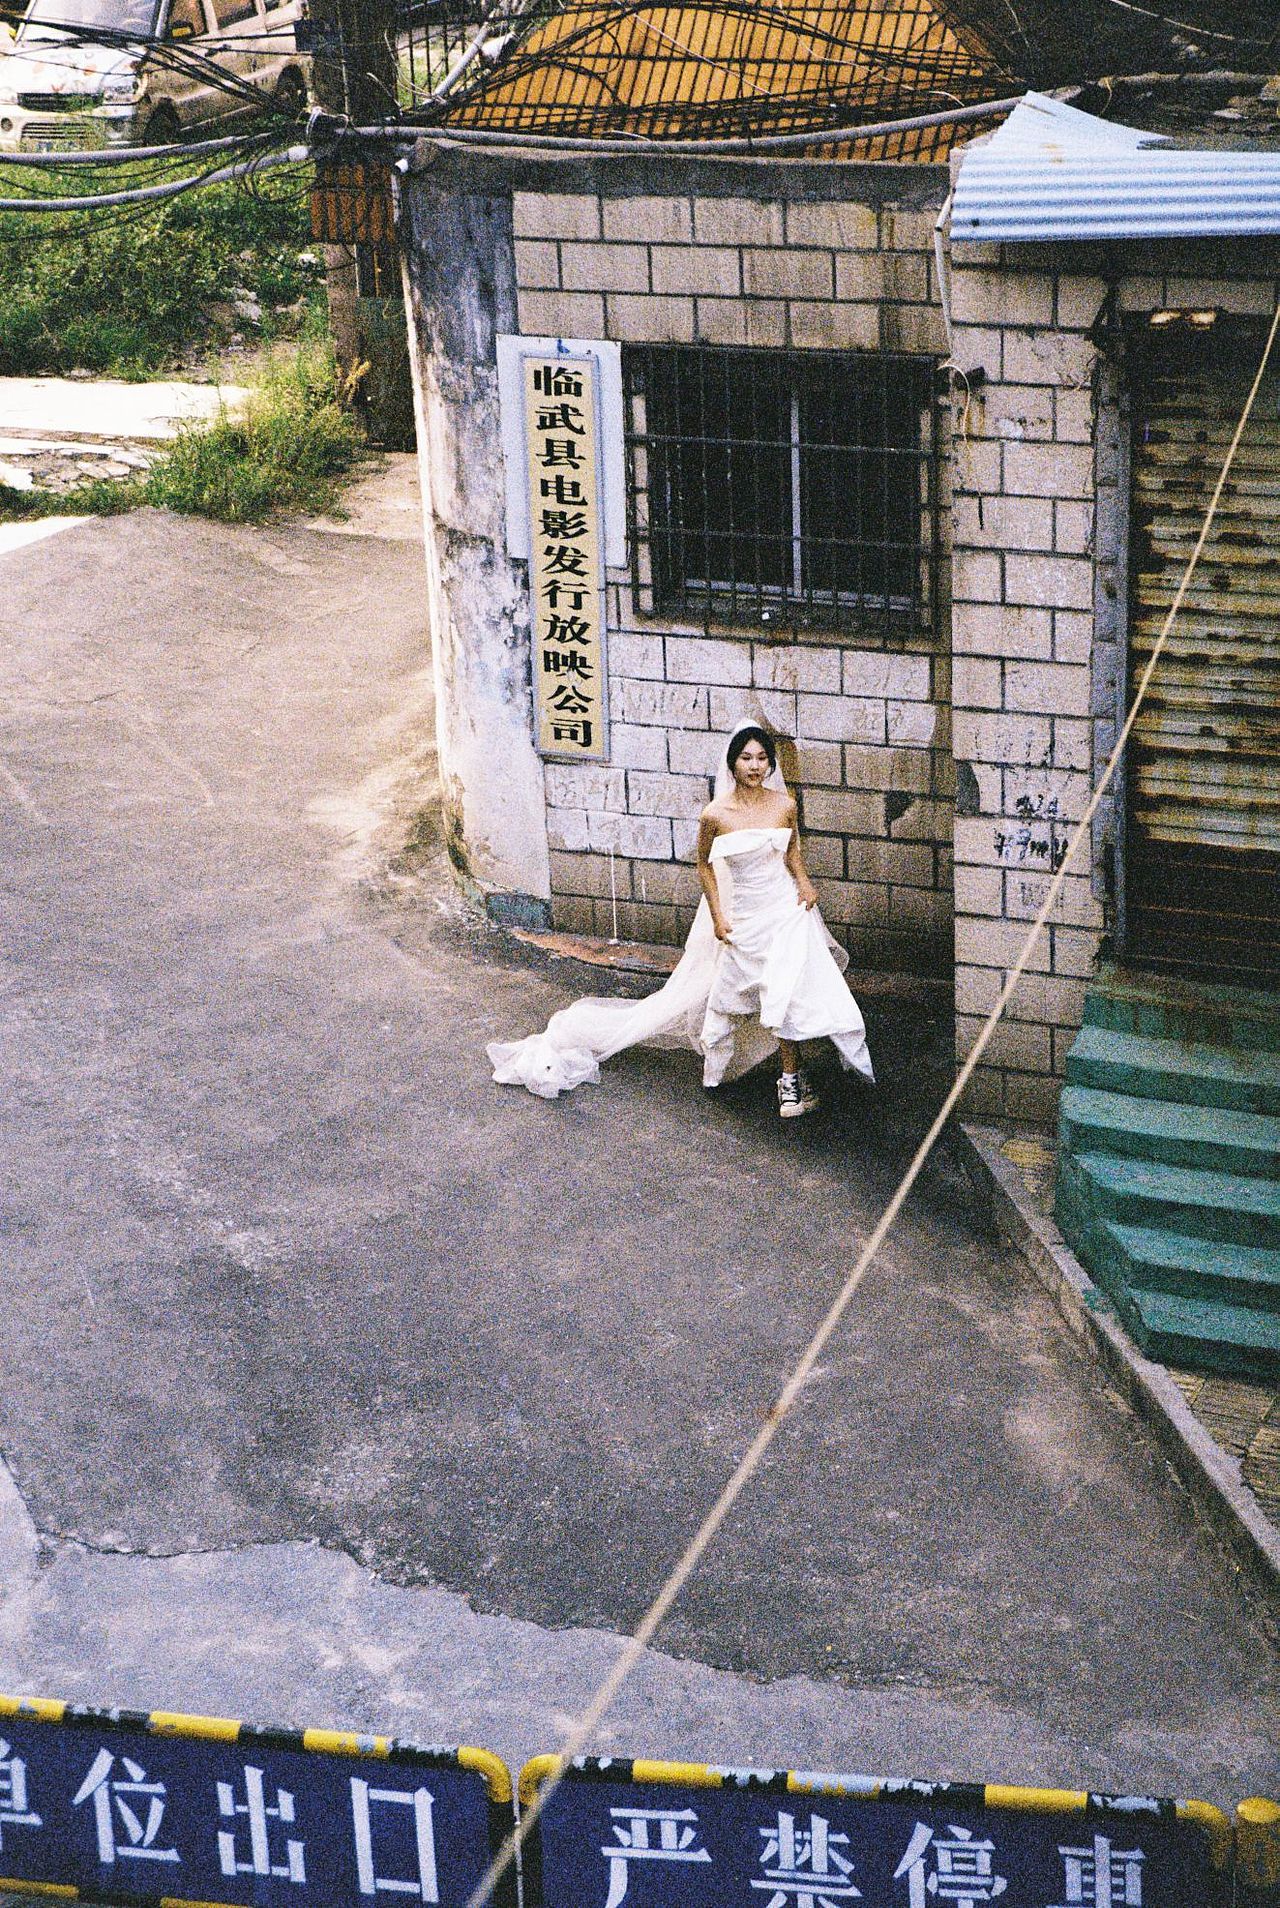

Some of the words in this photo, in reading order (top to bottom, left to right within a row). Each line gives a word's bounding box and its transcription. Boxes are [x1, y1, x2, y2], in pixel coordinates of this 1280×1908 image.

[533, 365, 595, 747] 临武县电影发行放映公司
